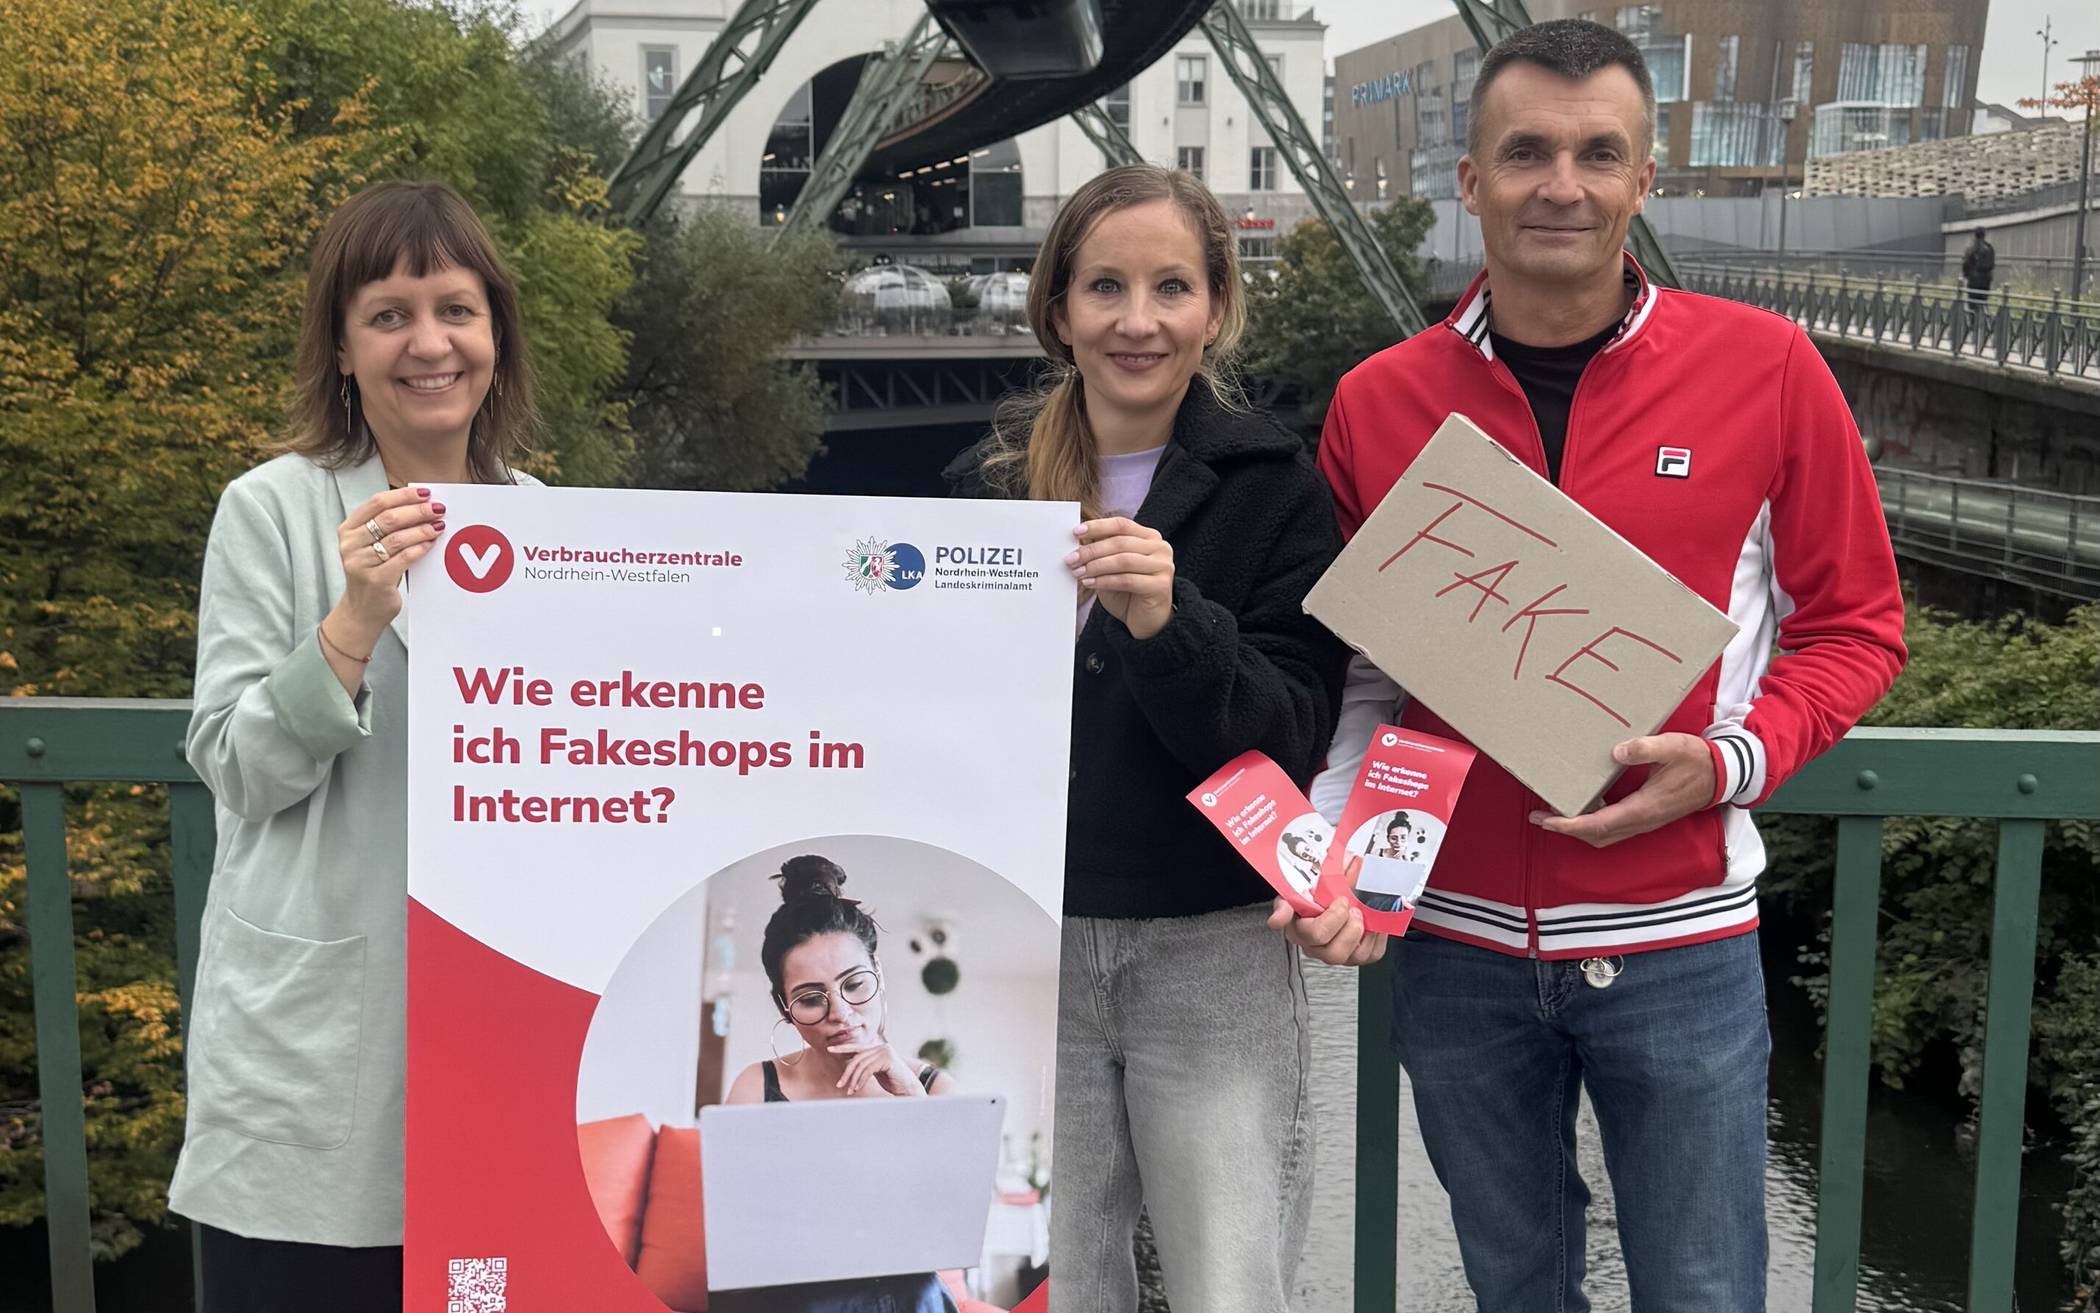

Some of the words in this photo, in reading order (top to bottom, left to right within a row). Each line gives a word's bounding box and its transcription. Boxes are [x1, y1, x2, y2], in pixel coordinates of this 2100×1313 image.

[1352, 70, 1410, 106] PRIMARK
[523, 546, 743, 566] Verbraucherzentrale
[935, 546, 1022, 565] POLIZEI
[524, 567, 690, 583] Nordrhein-Westfalen
[901, 570, 923, 581] LKA
[935, 567, 1039, 579] Nordrhein-Westfalen
[935, 580, 1032, 591] Landeskriminalamt
[1378, 482, 1682, 728] FAKE
[452, 667, 553, 706] Wie
[570, 671, 765, 710] erkenne
[453, 725, 521, 765] ich
[540, 728, 792, 776] Fakeshops
[809, 730, 865, 769] im
[1367, 769, 1382, 780] ich
[1372, 760, 1391, 772] Wie
[1364, 779, 1377, 789] im
[1377, 782, 1419, 798] Internet?
[453, 785, 676, 824] Internet?
